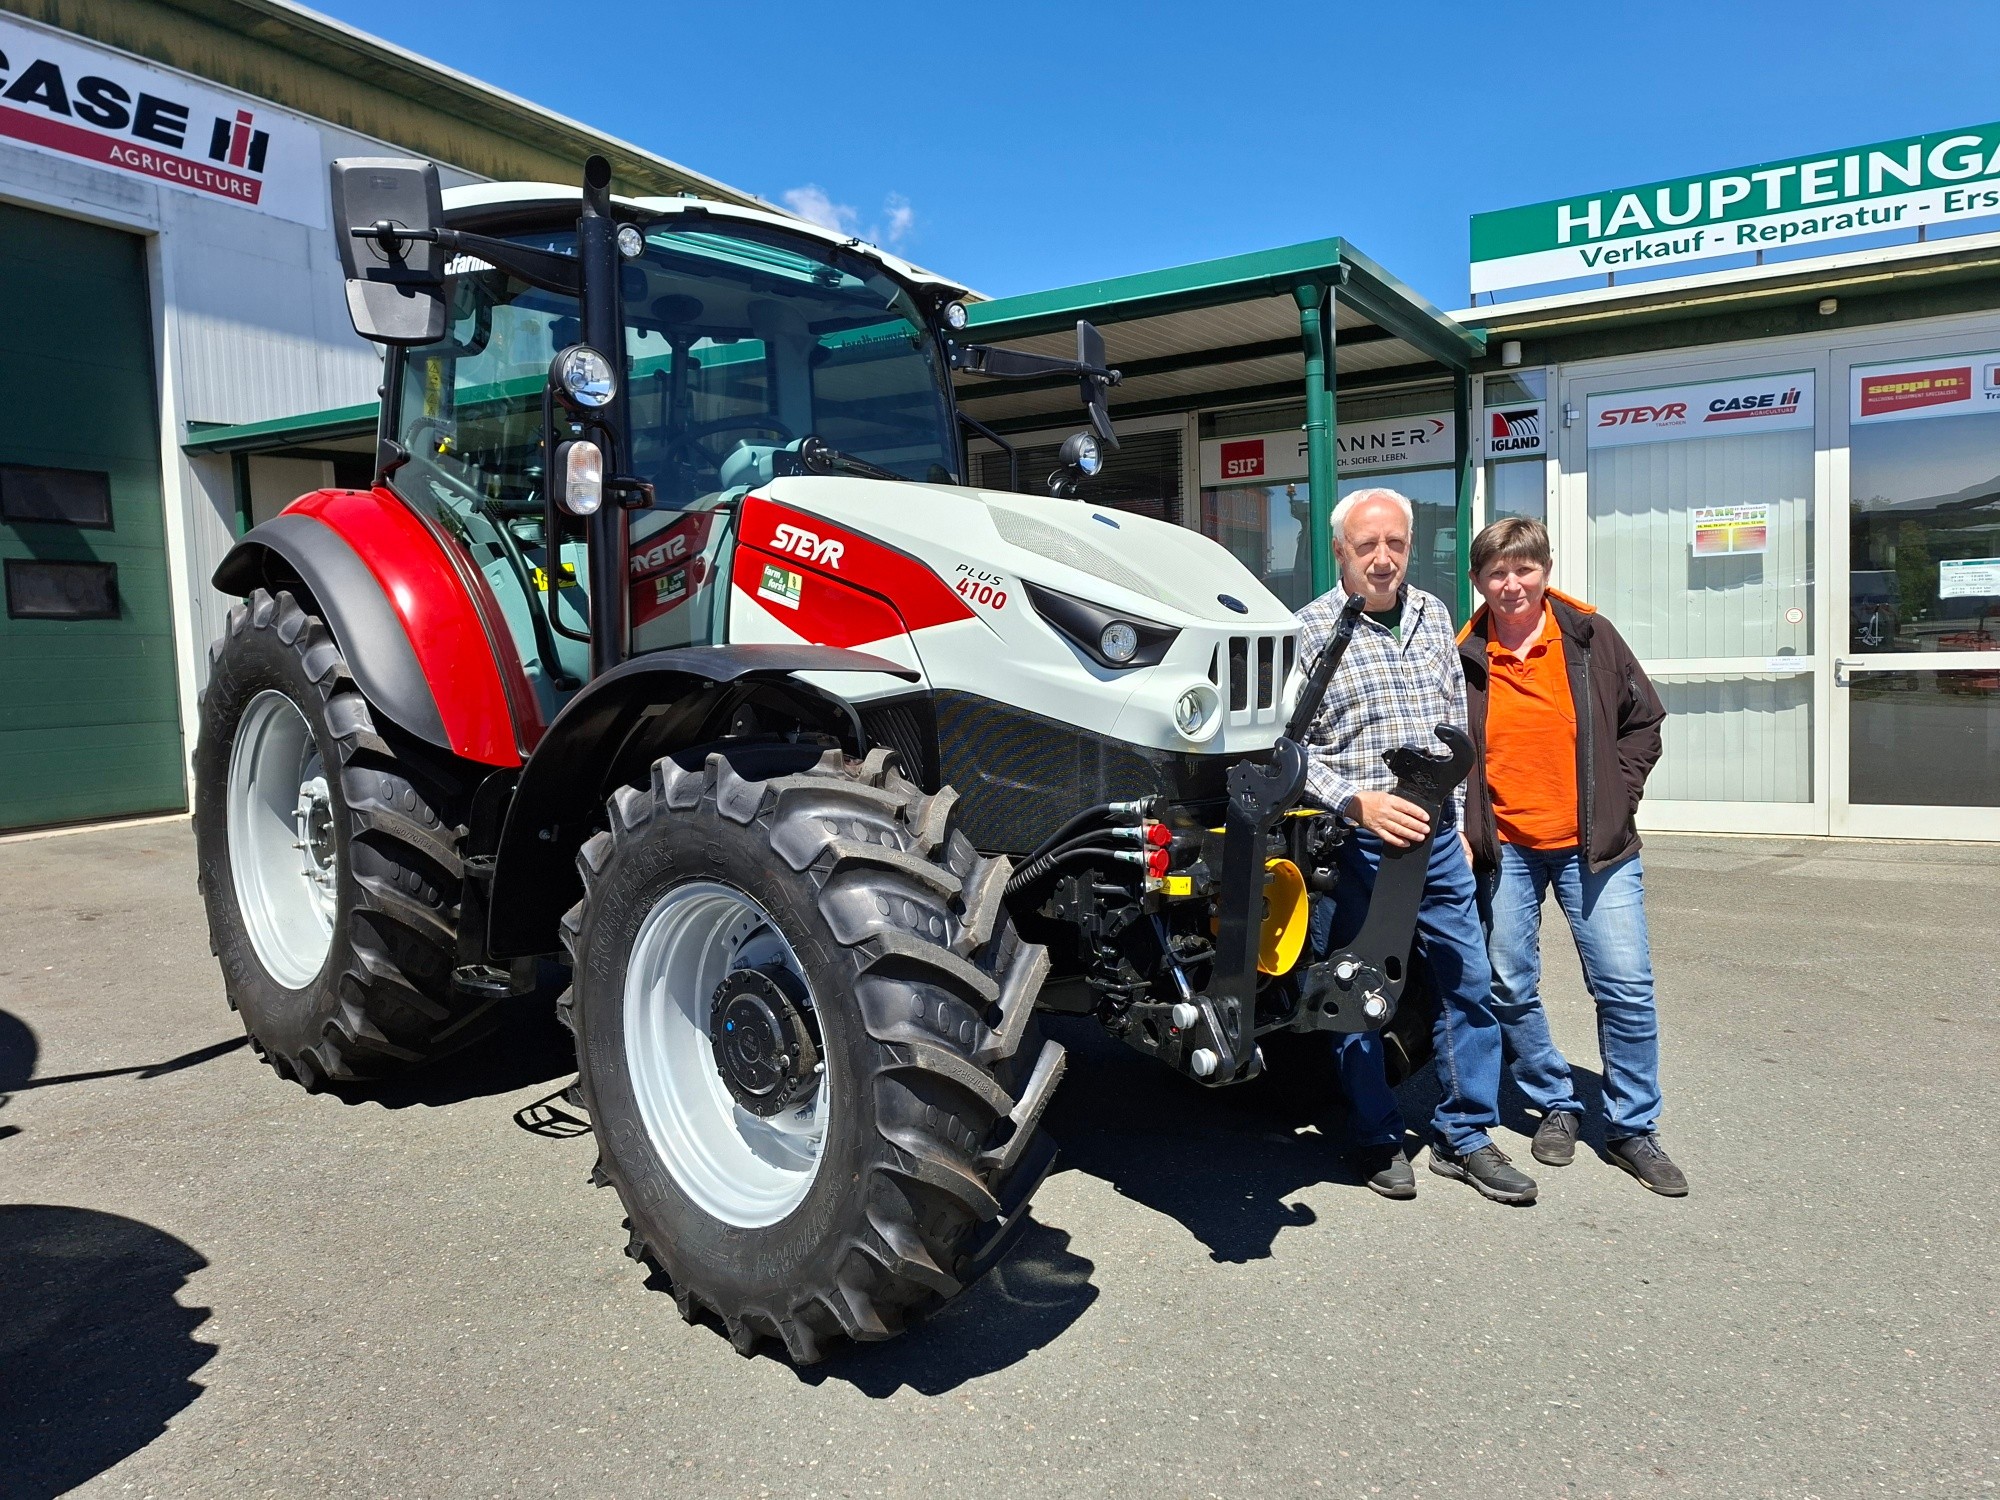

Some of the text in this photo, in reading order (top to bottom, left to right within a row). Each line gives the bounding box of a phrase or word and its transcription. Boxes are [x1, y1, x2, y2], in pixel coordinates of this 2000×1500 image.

[0, 49, 190, 150] ASE
[109, 145, 253, 198] AGRICULTURE
[1580, 230, 1704, 268] Verkauf
[1736, 203, 1908, 245] Reparatur
[1868, 378, 1931, 394] seppi
[1708, 393, 1775, 413] CASE
[1749, 406, 1795, 417] AGRICULTURE
[1597, 402, 1687, 428] STEYR
[1655, 420, 1687, 428] TRAKTOREN
[1491, 436, 1540, 452] IGLAND
[1228, 458, 1258, 475] SIP
[1351, 455, 1380, 466] SICHER.
[1381, 452, 1409, 463] LEBEN.
[769, 523, 845, 570] STEYR
[764, 565, 782, 579] farm
[955, 563, 1004, 586] PLUS
[767, 577, 786, 593] forst
[955, 577, 1007, 610] 4100
